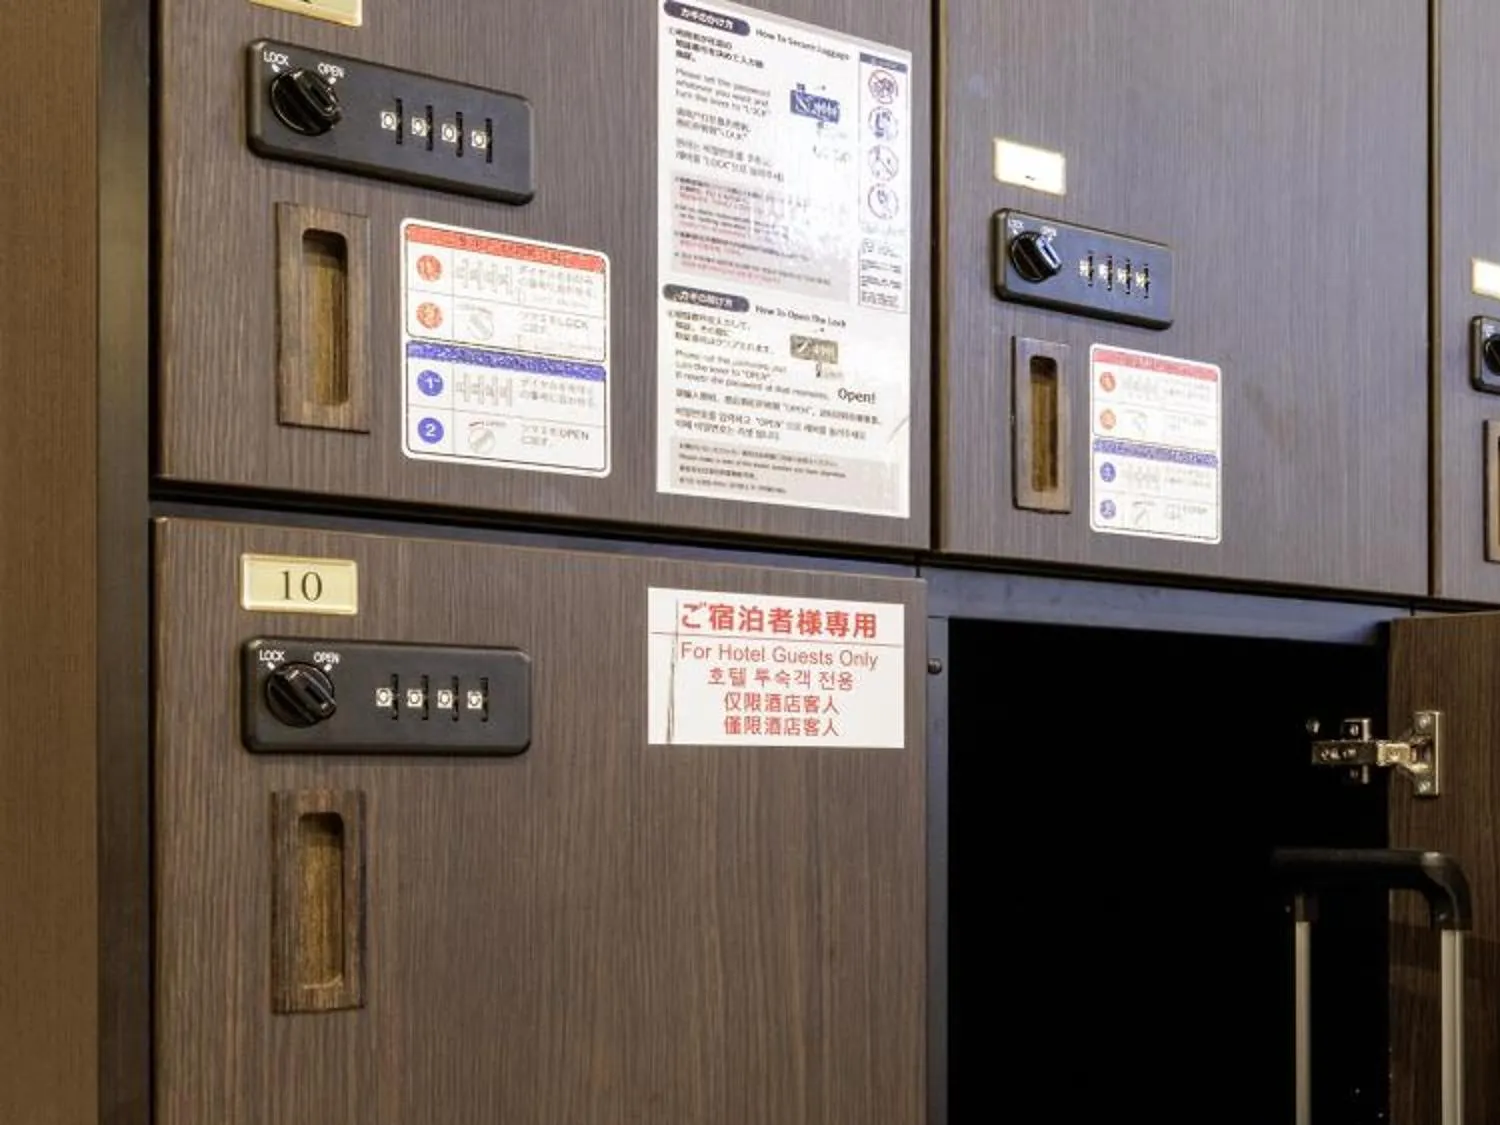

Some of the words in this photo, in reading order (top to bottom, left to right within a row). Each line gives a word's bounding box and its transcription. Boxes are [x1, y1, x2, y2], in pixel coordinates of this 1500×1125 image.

[263, 51, 289, 67] LOCK
[317, 62, 345, 78] OPEN
[837, 387, 876, 405] Open!
[281, 570, 323, 602] 10
[681, 601, 877, 639] ご宿泊者様専用
[259, 649, 286, 663] LOCK
[313, 651, 341, 665] OPEN
[681, 642, 713, 660] For
[718, 642, 766, 663] Hotel
[772, 645, 833, 666] Guests
[839, 649, 879, 671] Only
[708, 667, 748, 688] 호텔
[754, 667, 812, 689] 투숙객
[818, 670, 854, 692] 전용
[723, 691, 841, 715] 仅限酒店客人
[723, 715, 840, 737] 僅限酒店客人
